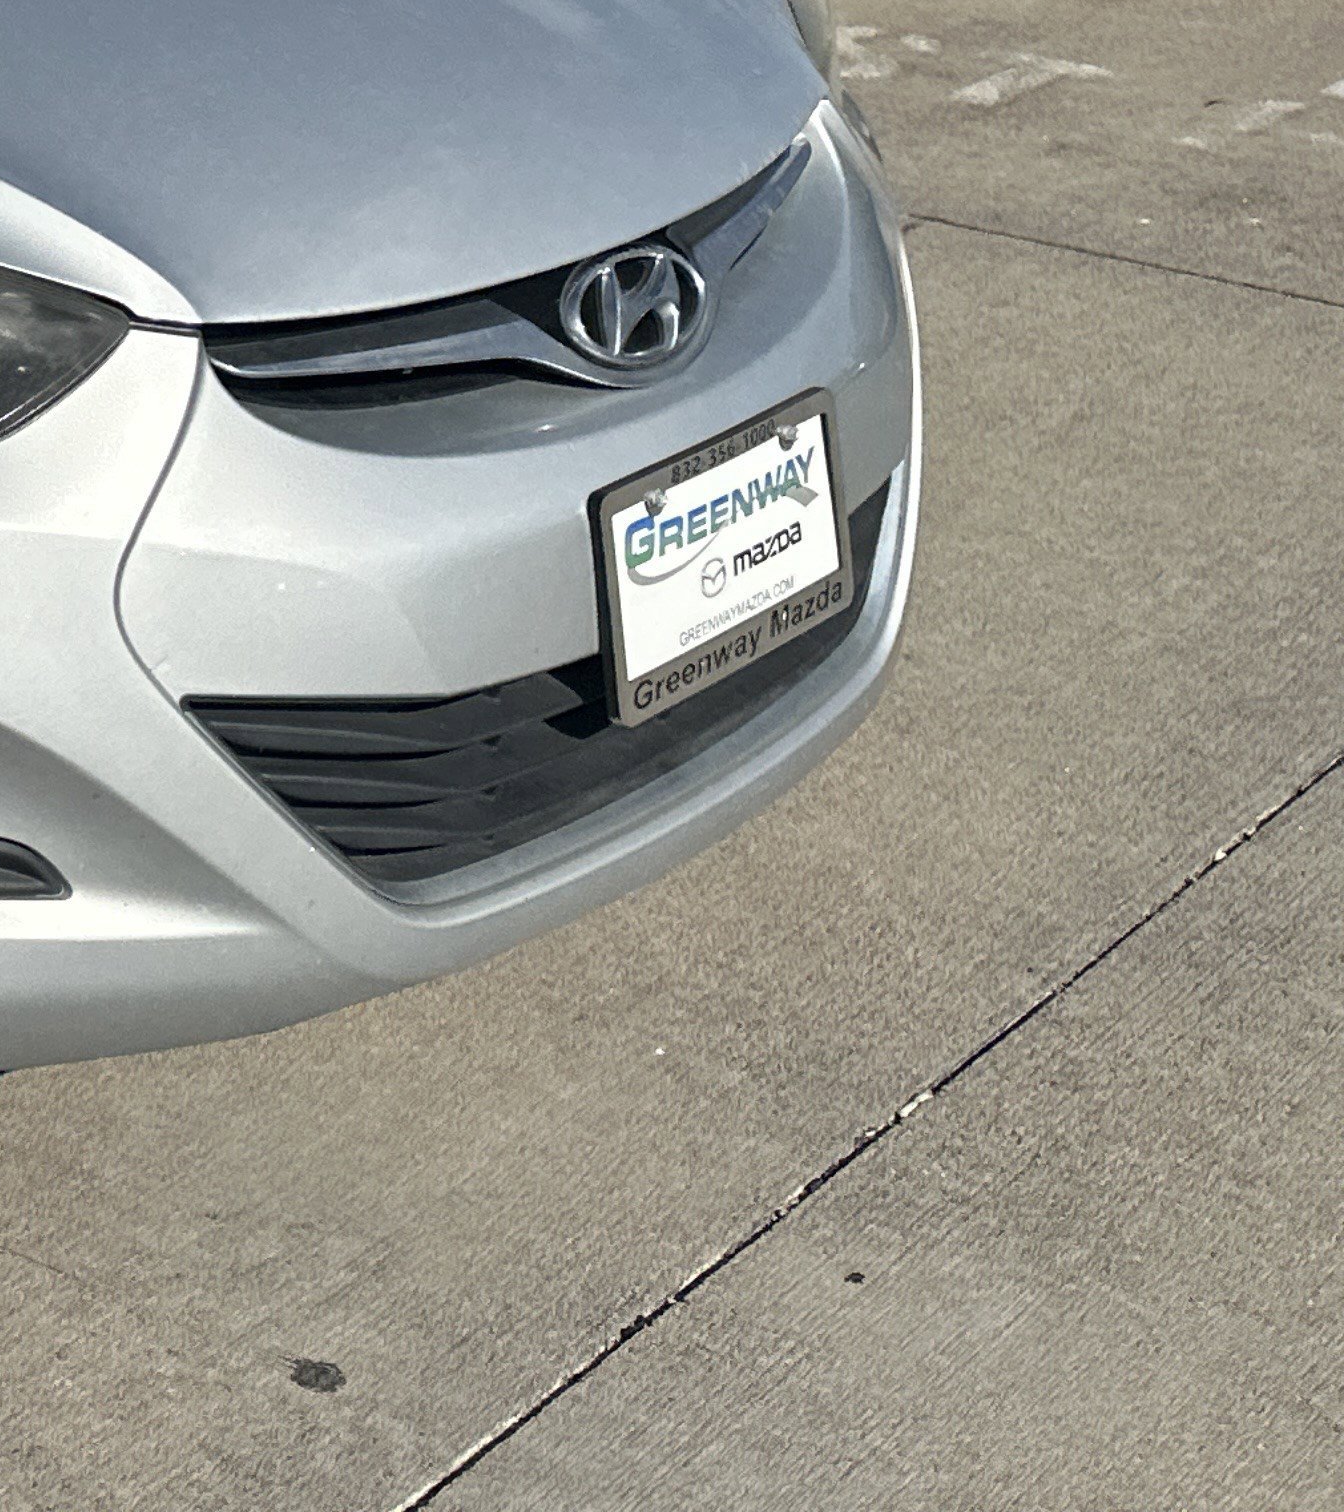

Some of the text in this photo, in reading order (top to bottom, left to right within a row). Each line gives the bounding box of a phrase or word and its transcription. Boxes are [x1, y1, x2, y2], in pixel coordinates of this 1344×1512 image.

[625, 445, 815, 570] GREENWAY
[733, 521, 802, 576] mazda
[633, 580, 843, 710] Greenway Mazda
